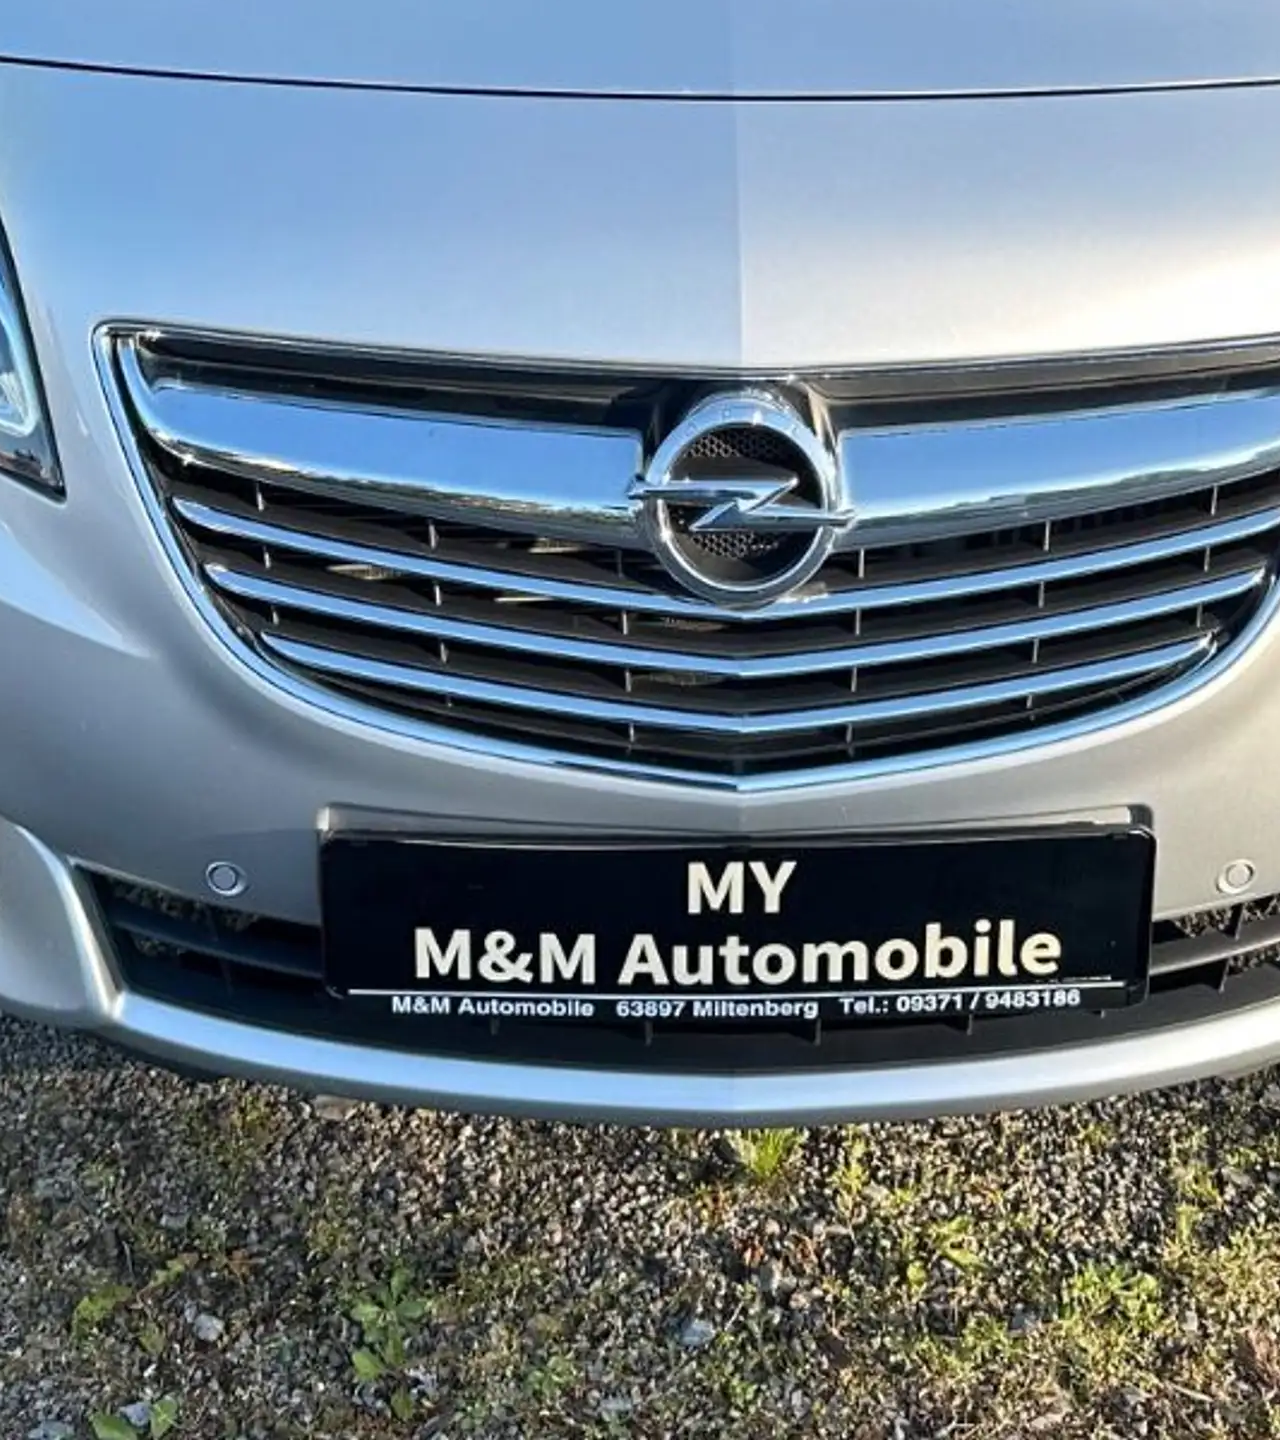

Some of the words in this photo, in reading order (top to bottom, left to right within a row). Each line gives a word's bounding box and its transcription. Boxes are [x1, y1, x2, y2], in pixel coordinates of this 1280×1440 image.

[687, 861, 797, 914] MY
[414, 927, 596, 985] M&M
[617, 918, 1062, 986] Automobile
[391, 996, 451, 1015] M&M
[458, 996, 595, 1017] Automobile
[616, 1000, 684, 1017] 63897
[693, 999, 819, 1020] Miltenberg
[839, 996, 888, 1014] Tel.:
[896, 993, 963, 1012] 09371
[985, 988, 1081, 1009] 9483186
